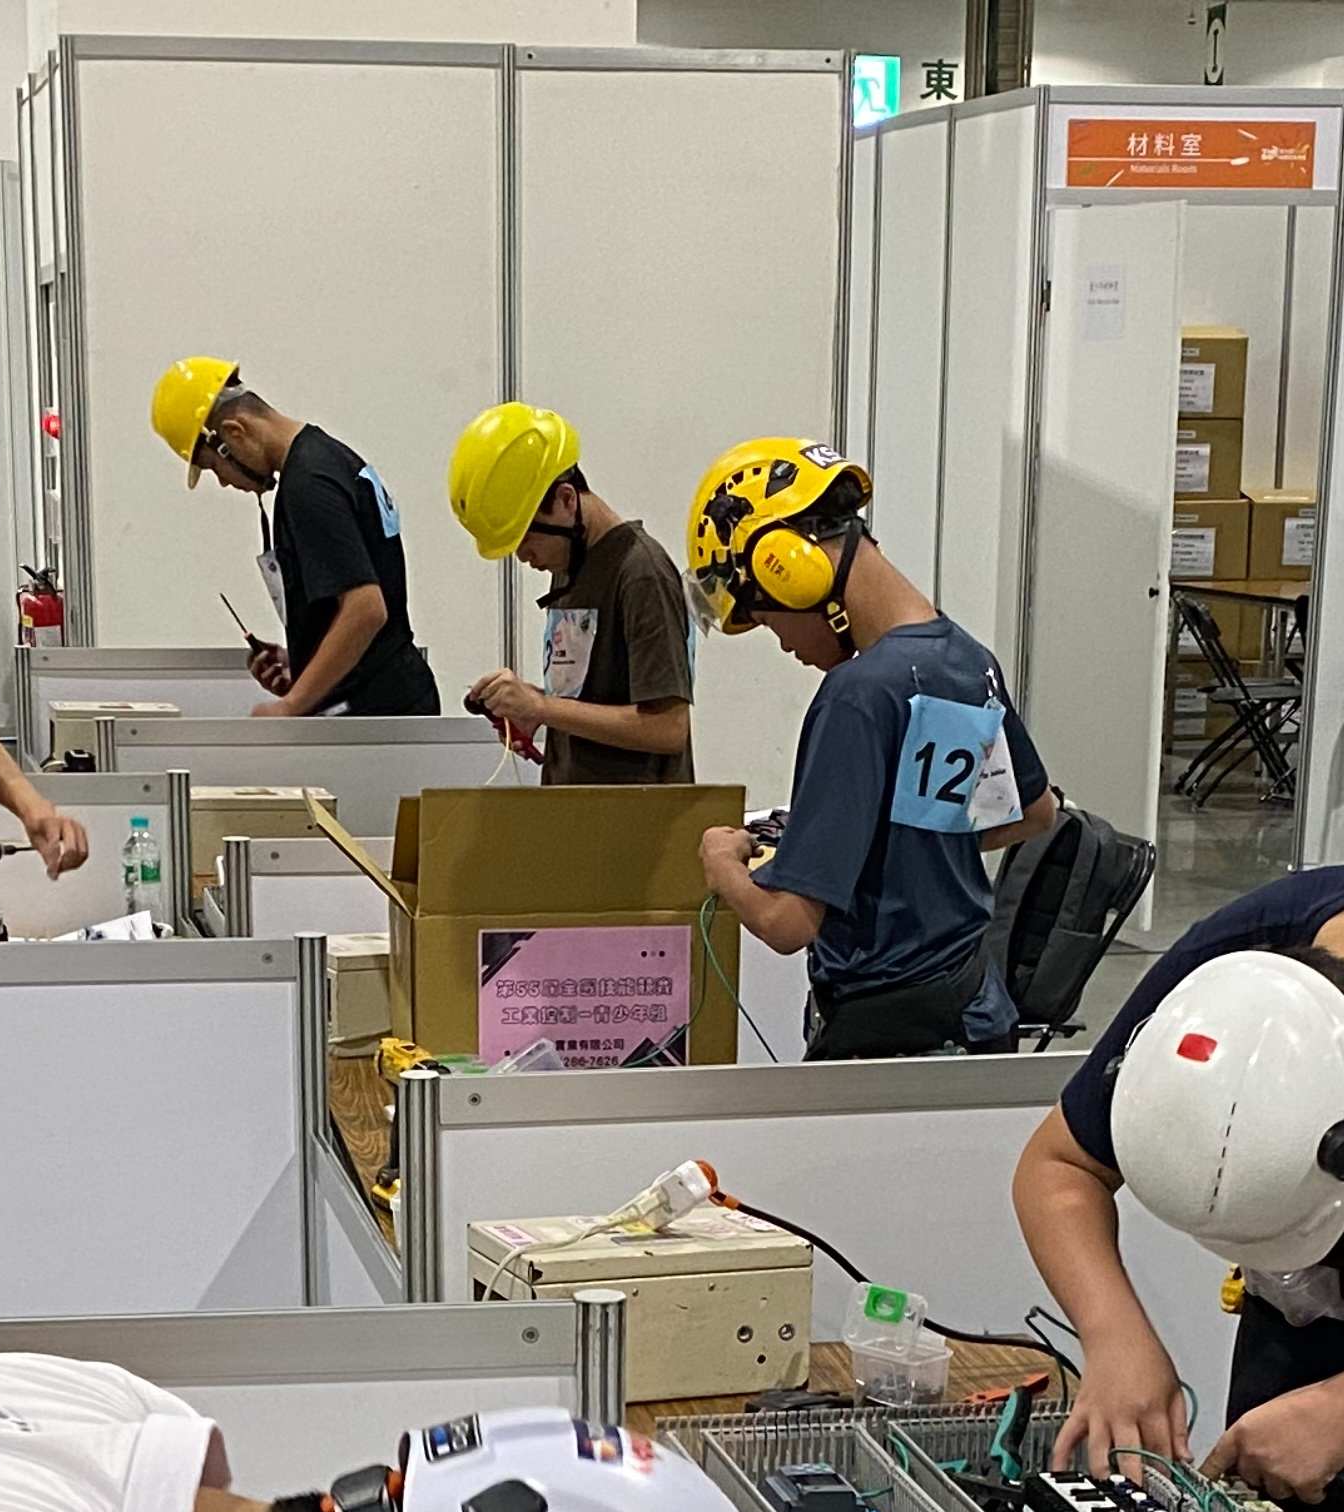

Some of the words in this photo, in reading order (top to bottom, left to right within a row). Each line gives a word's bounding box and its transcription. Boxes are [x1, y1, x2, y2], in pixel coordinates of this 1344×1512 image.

[920, 58, 959, 101] 東
[1127, 132, 1203, 157] 材料室
[914, 742, 976, 805] 12
